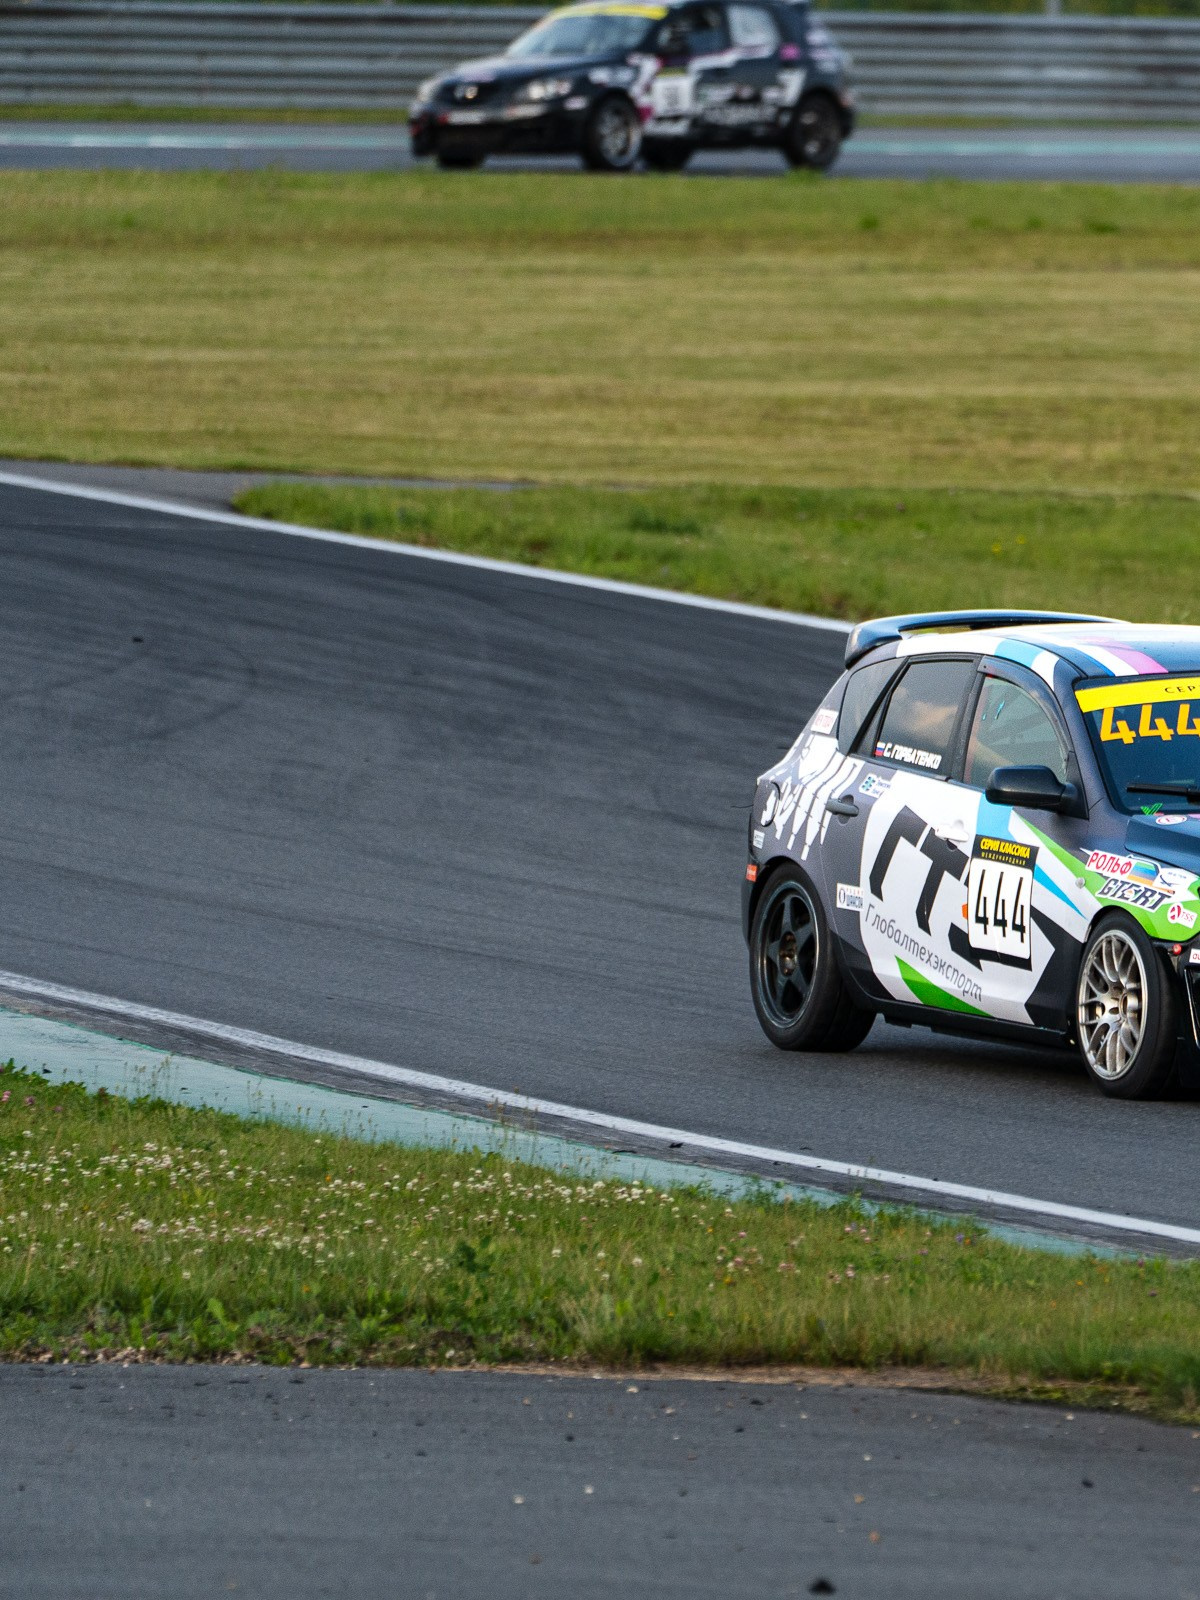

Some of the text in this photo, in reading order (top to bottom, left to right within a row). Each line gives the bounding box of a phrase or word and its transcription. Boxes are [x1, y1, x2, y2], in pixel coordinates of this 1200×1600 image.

[891, 744, 943, 770] ГОРБАТЕНКО
[980, 838, 1031, 859] СЕРИЯ КЛАССИКА
[1087, 851, 1133, 876] РОЛЬФ
[975, 869, 1026, 943] 444
[864, 903, 983, 1002] Глобалтехэкспорт
